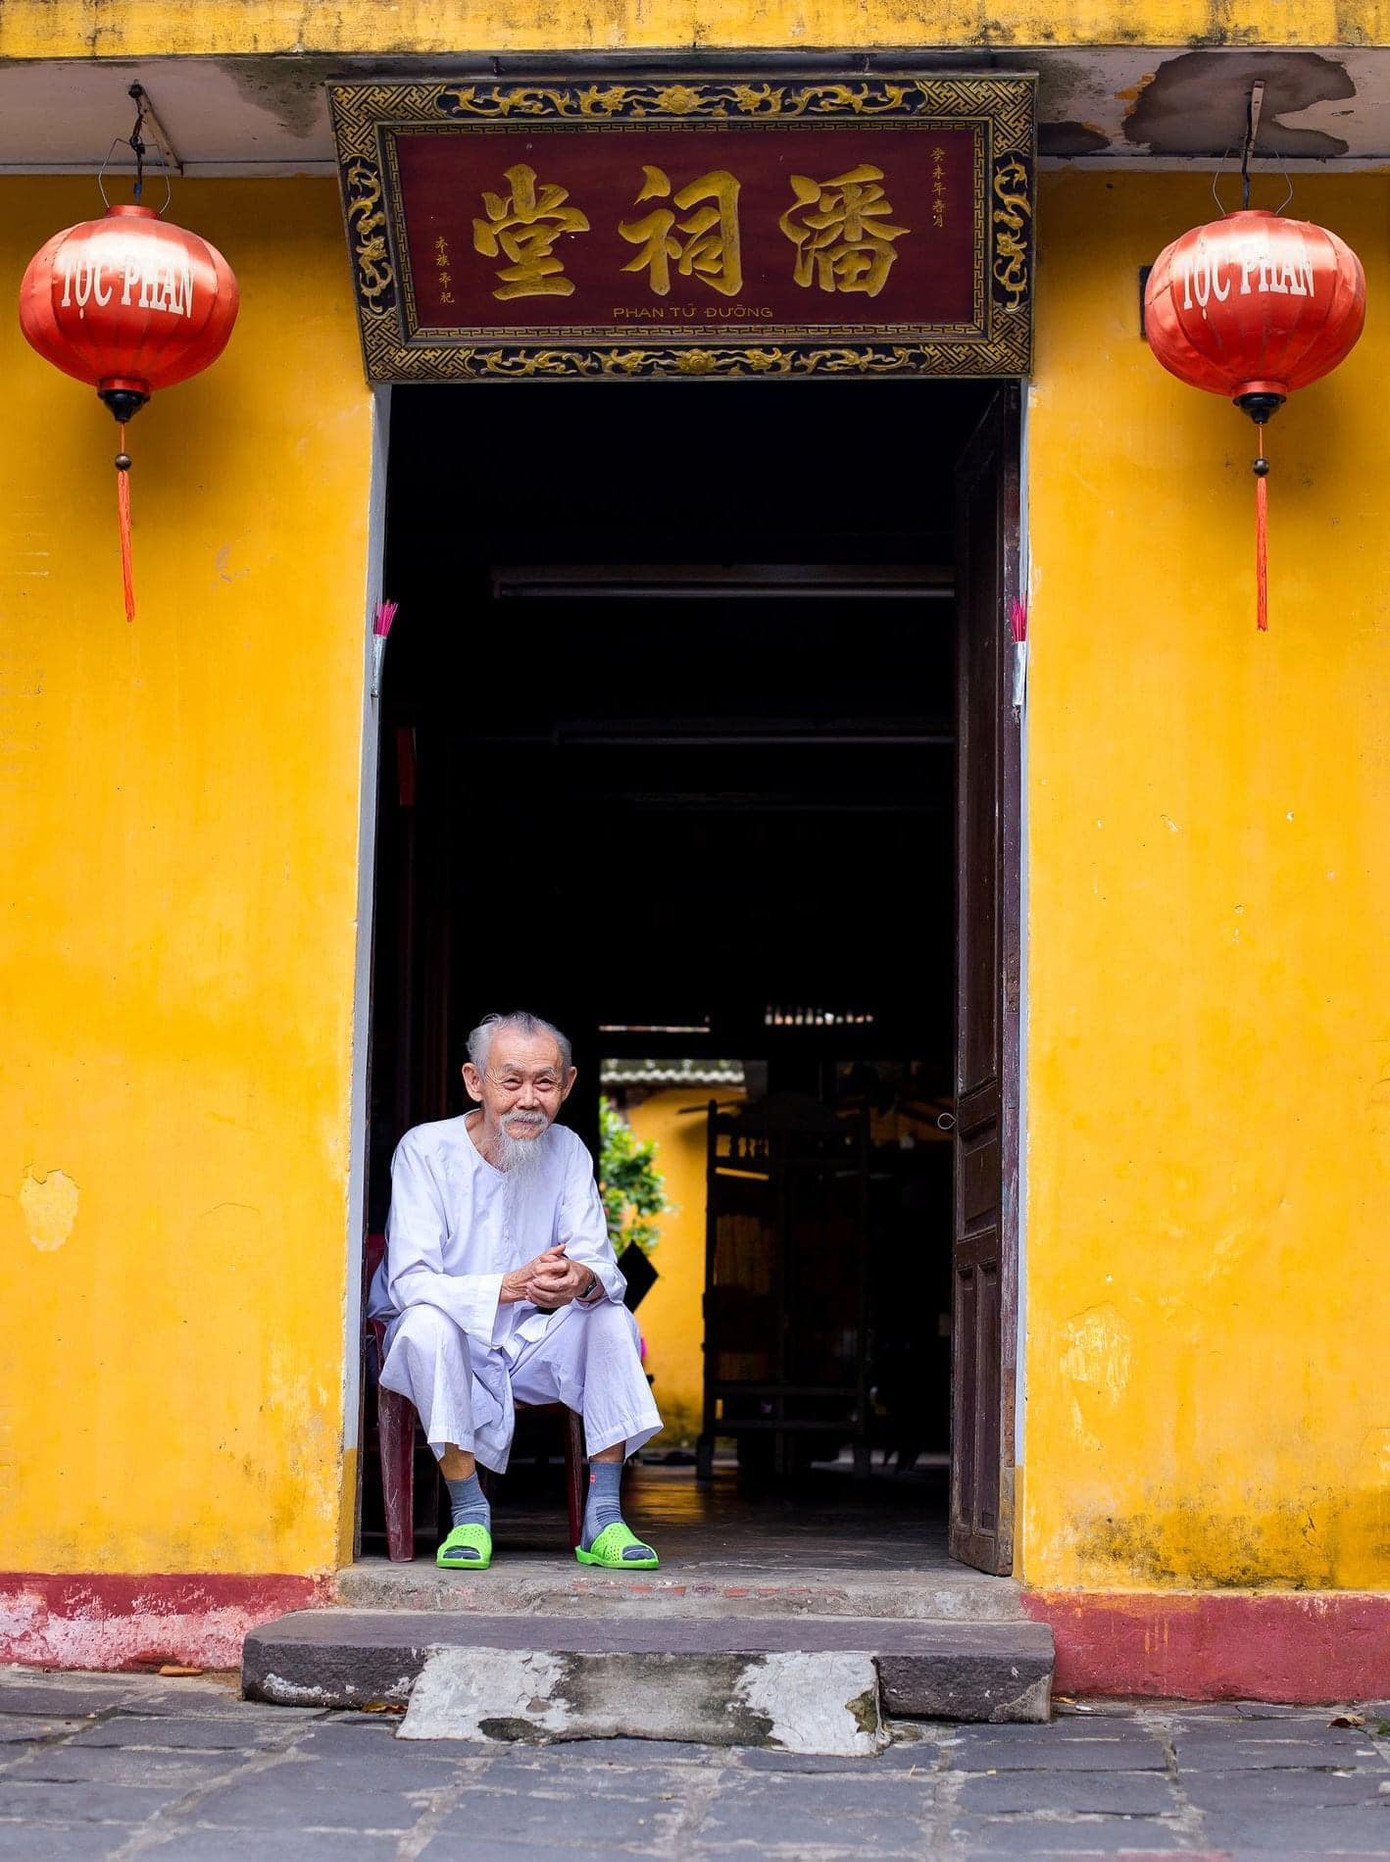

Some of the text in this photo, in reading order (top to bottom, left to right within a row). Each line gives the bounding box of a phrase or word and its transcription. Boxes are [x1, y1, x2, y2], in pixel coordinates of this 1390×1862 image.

[120, 253, 195, 320] PHAN
[1239, 246, 1316, 298] PHAN
[612, 306, 665, 319] PHAN
